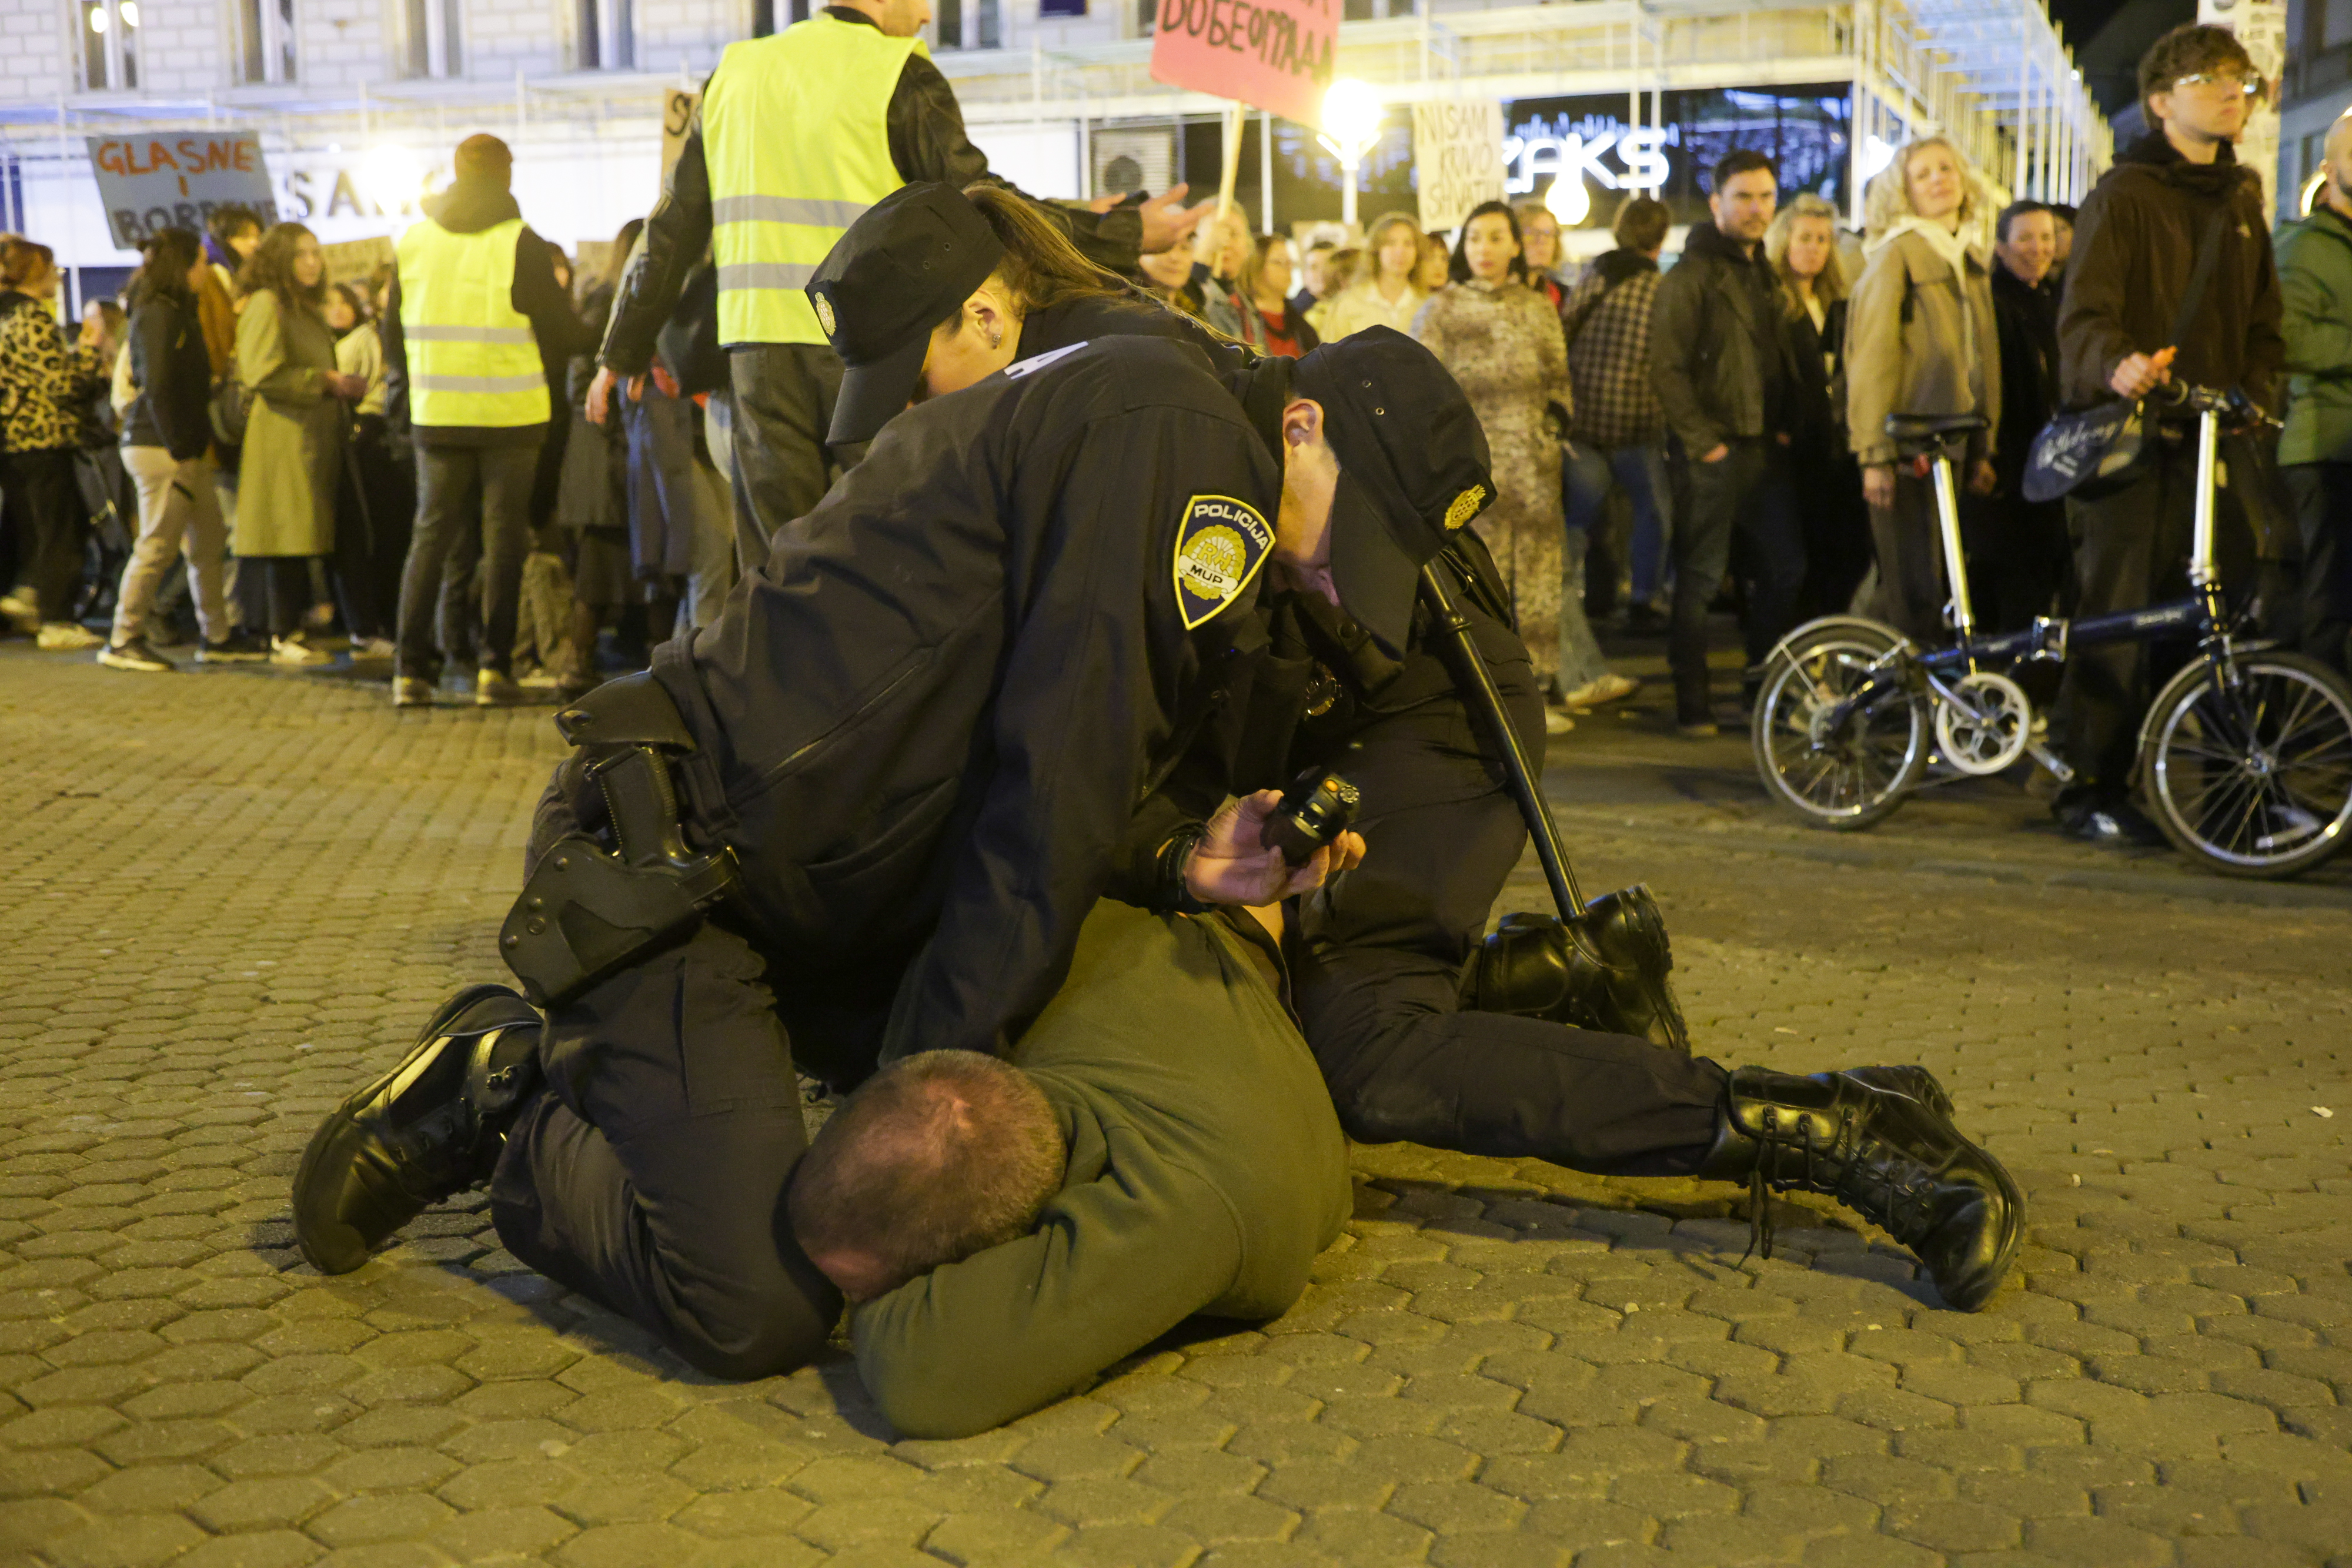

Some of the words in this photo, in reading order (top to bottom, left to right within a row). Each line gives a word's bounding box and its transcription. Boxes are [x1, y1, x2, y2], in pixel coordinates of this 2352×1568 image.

[98, 140, 257, 176] GLASNE
[178, 175, 189, 197] I
[1194, 504, 1269, 550] POLICIJA
[1198, 543, 1234, 571] RH
[1190, 564, 1222, 584] MUP
